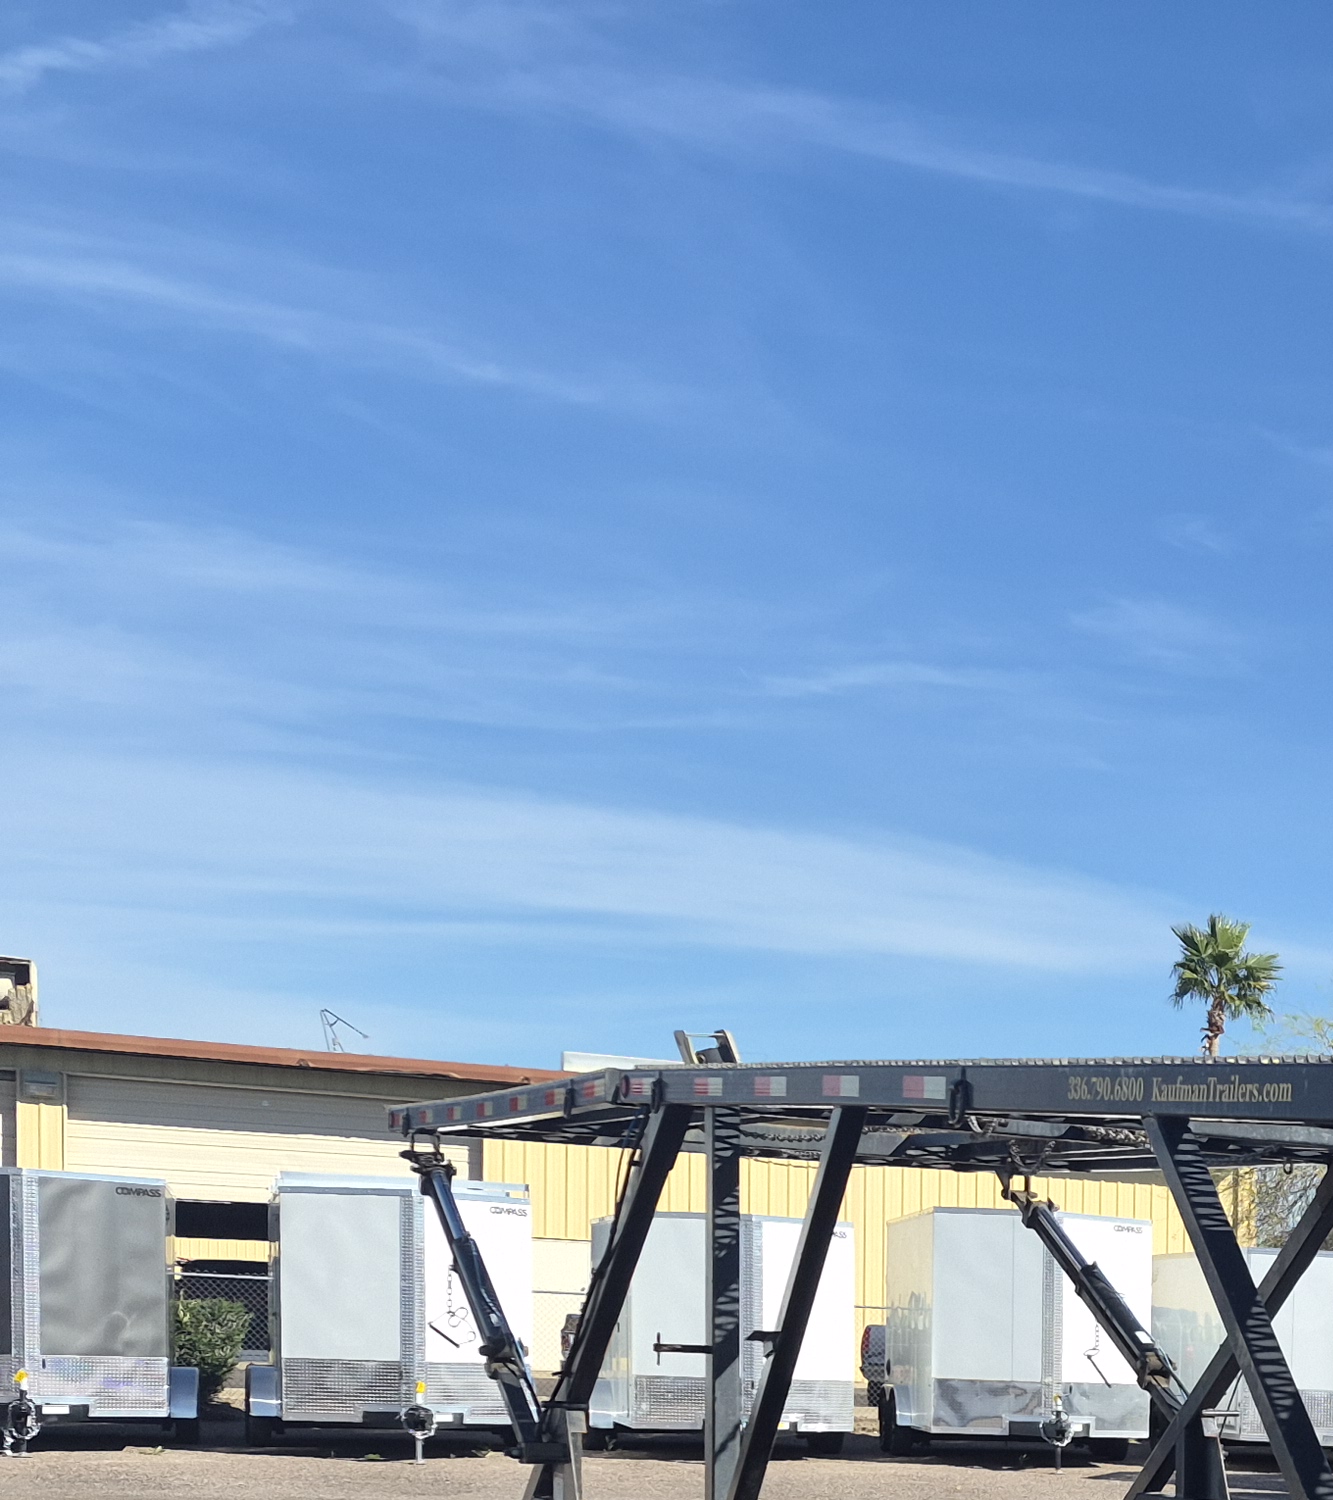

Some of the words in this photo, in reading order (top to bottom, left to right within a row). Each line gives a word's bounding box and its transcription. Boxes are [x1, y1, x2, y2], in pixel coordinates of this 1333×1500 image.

[1066, 1075, 1144, 1102] 336.790.6800
[1151, 1075, 1292, 1103] KaufmanTrailers.com
[116, 1186, 161, 1197] COMPASS
[491, 1206, 527, 1217] COMPASS
[1114, 1225, 1142, 1233] COMPASS
